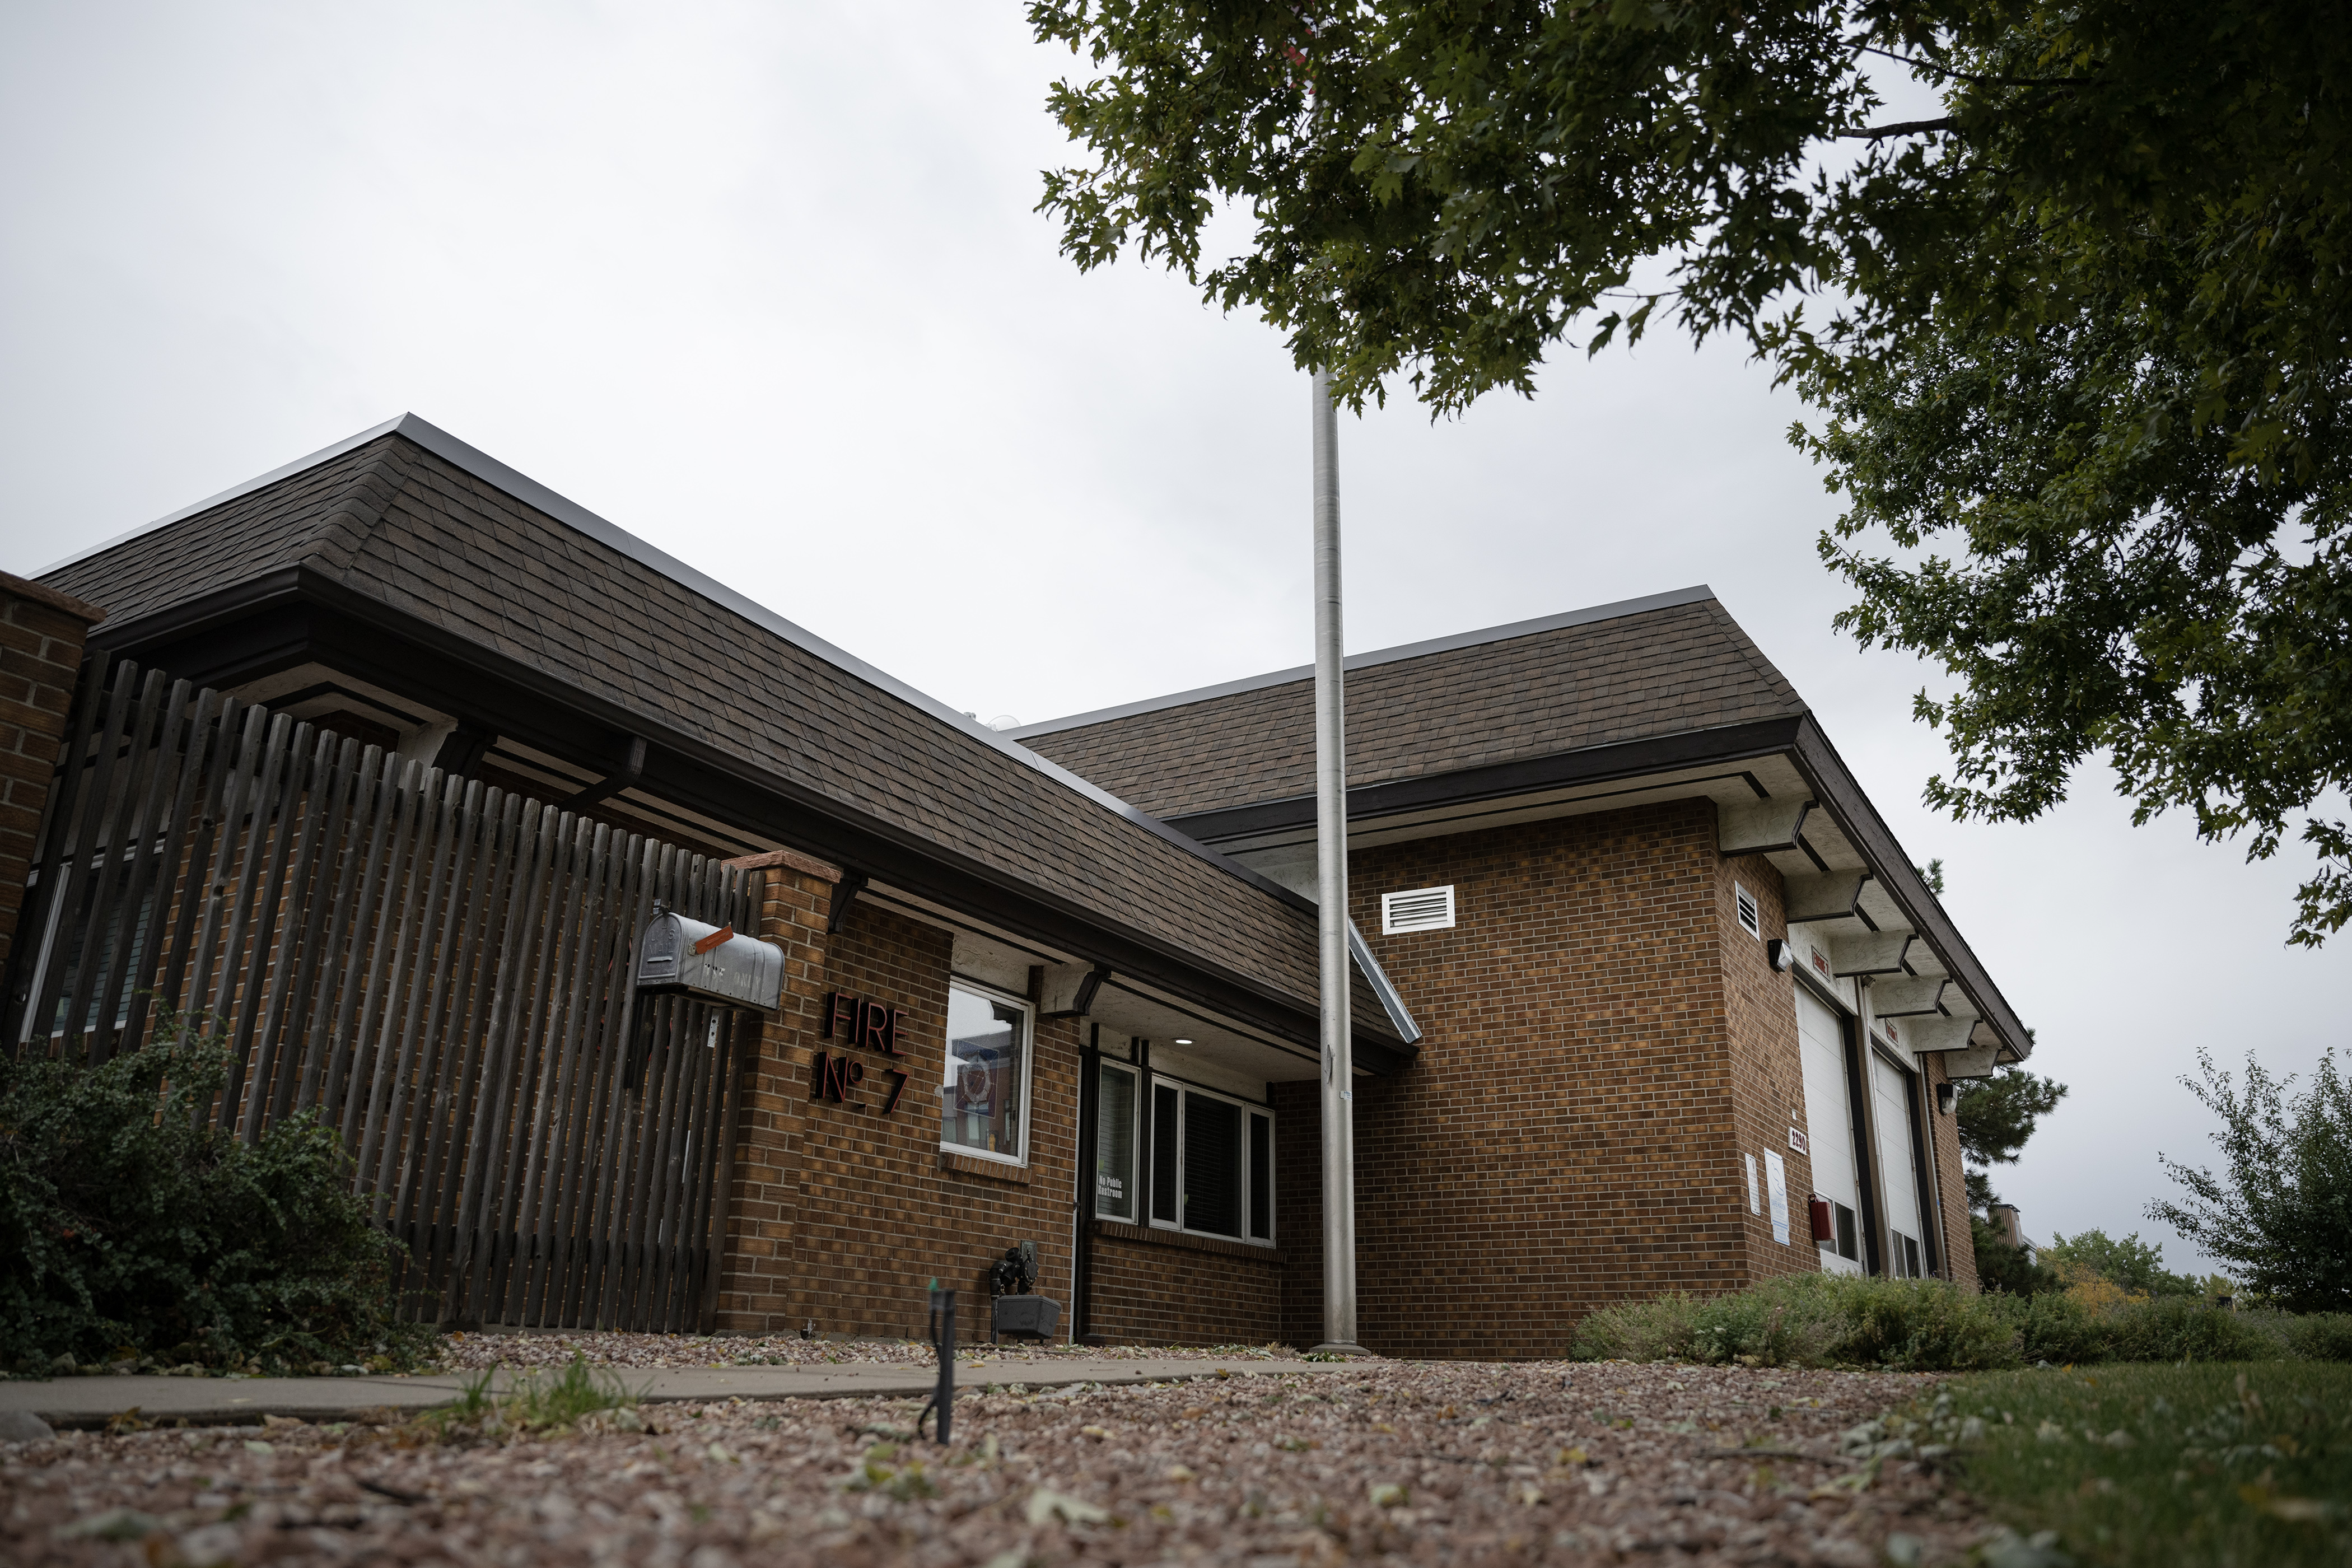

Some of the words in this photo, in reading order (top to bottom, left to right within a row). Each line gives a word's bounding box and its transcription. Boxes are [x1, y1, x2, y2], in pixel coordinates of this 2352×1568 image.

[824, 992, 909, 1057] FIRE
[883, 1068, 909, 1114] 7
[1792, 1130, 1806, 1151] 2290
[1098, 1184, 1122, 1199] Restroom
[1099, 1175, 1106, 1186] No
[1107, 1177, 1122, 1189] Public
